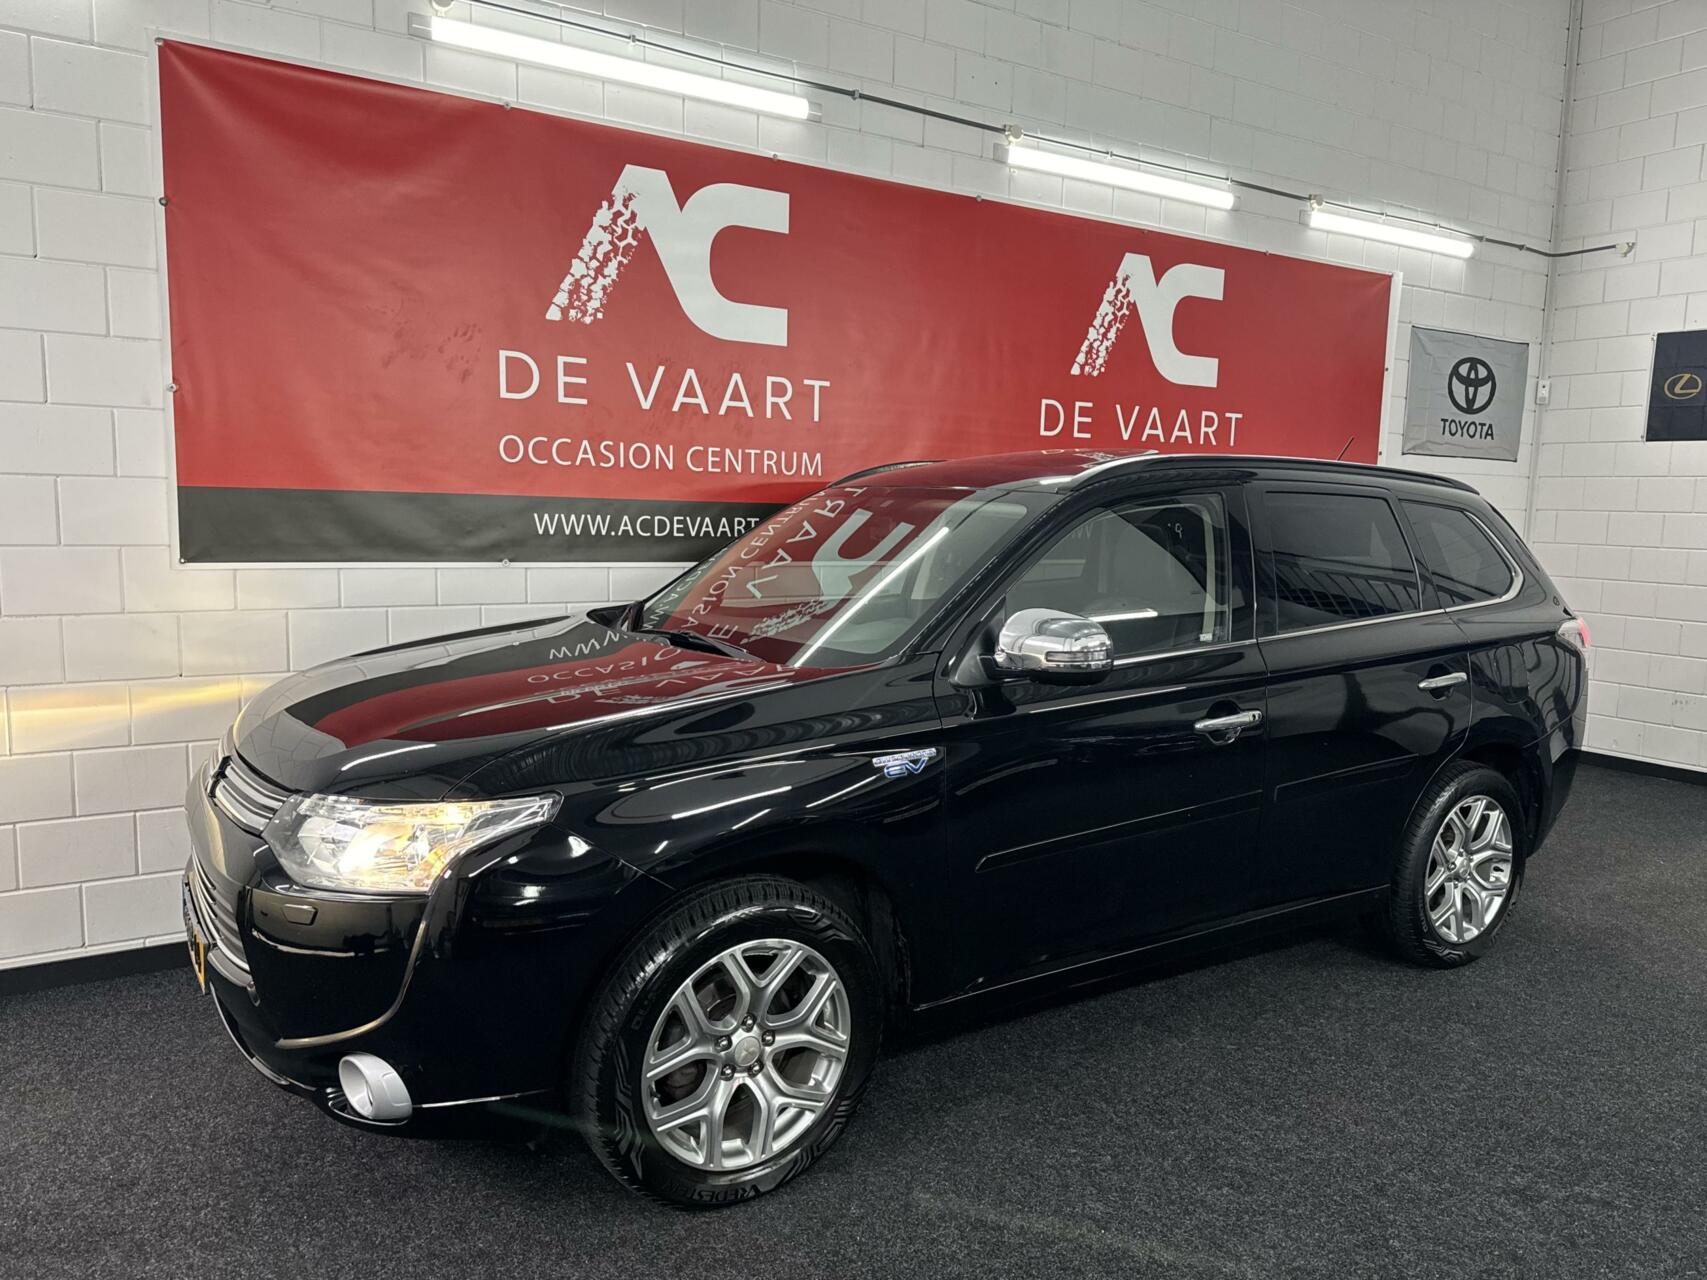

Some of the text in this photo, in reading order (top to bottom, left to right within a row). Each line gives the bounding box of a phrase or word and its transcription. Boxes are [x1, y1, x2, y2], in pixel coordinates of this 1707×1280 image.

[499, 349, 831, 422] DE VAART
[1039, 399, 1243, 447] DE VAART
[1440, 418, 1494, 441] TOYOTA
[499, 434, 823, 477] OCCASION CENTRUM
